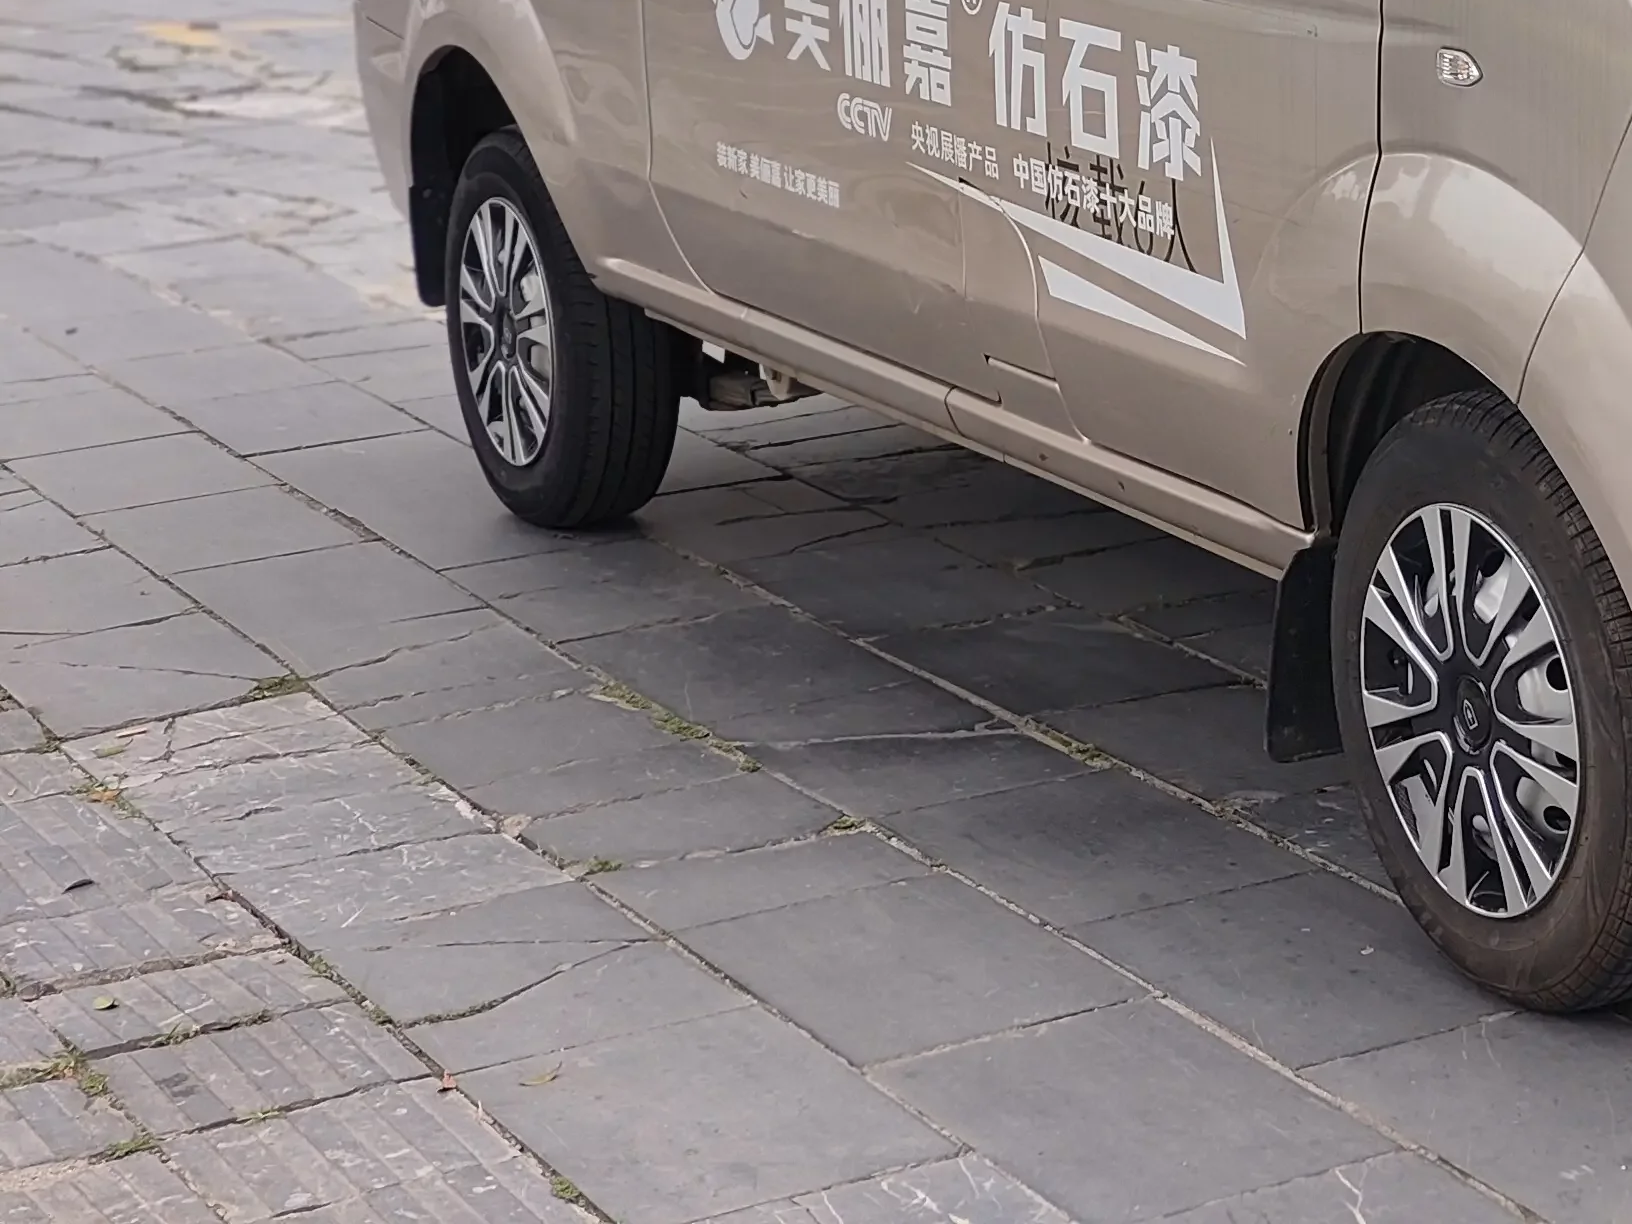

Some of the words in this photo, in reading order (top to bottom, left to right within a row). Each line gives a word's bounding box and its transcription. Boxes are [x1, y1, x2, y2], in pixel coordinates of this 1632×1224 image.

[837, 92, 893, 142] CCTV
[911, 121, 1000, 180] 央视展播产品
[1012, 152, 1175, 240] 中国仿石漆十大品牌
[988, 0, 1202, 182] 仿石漆
